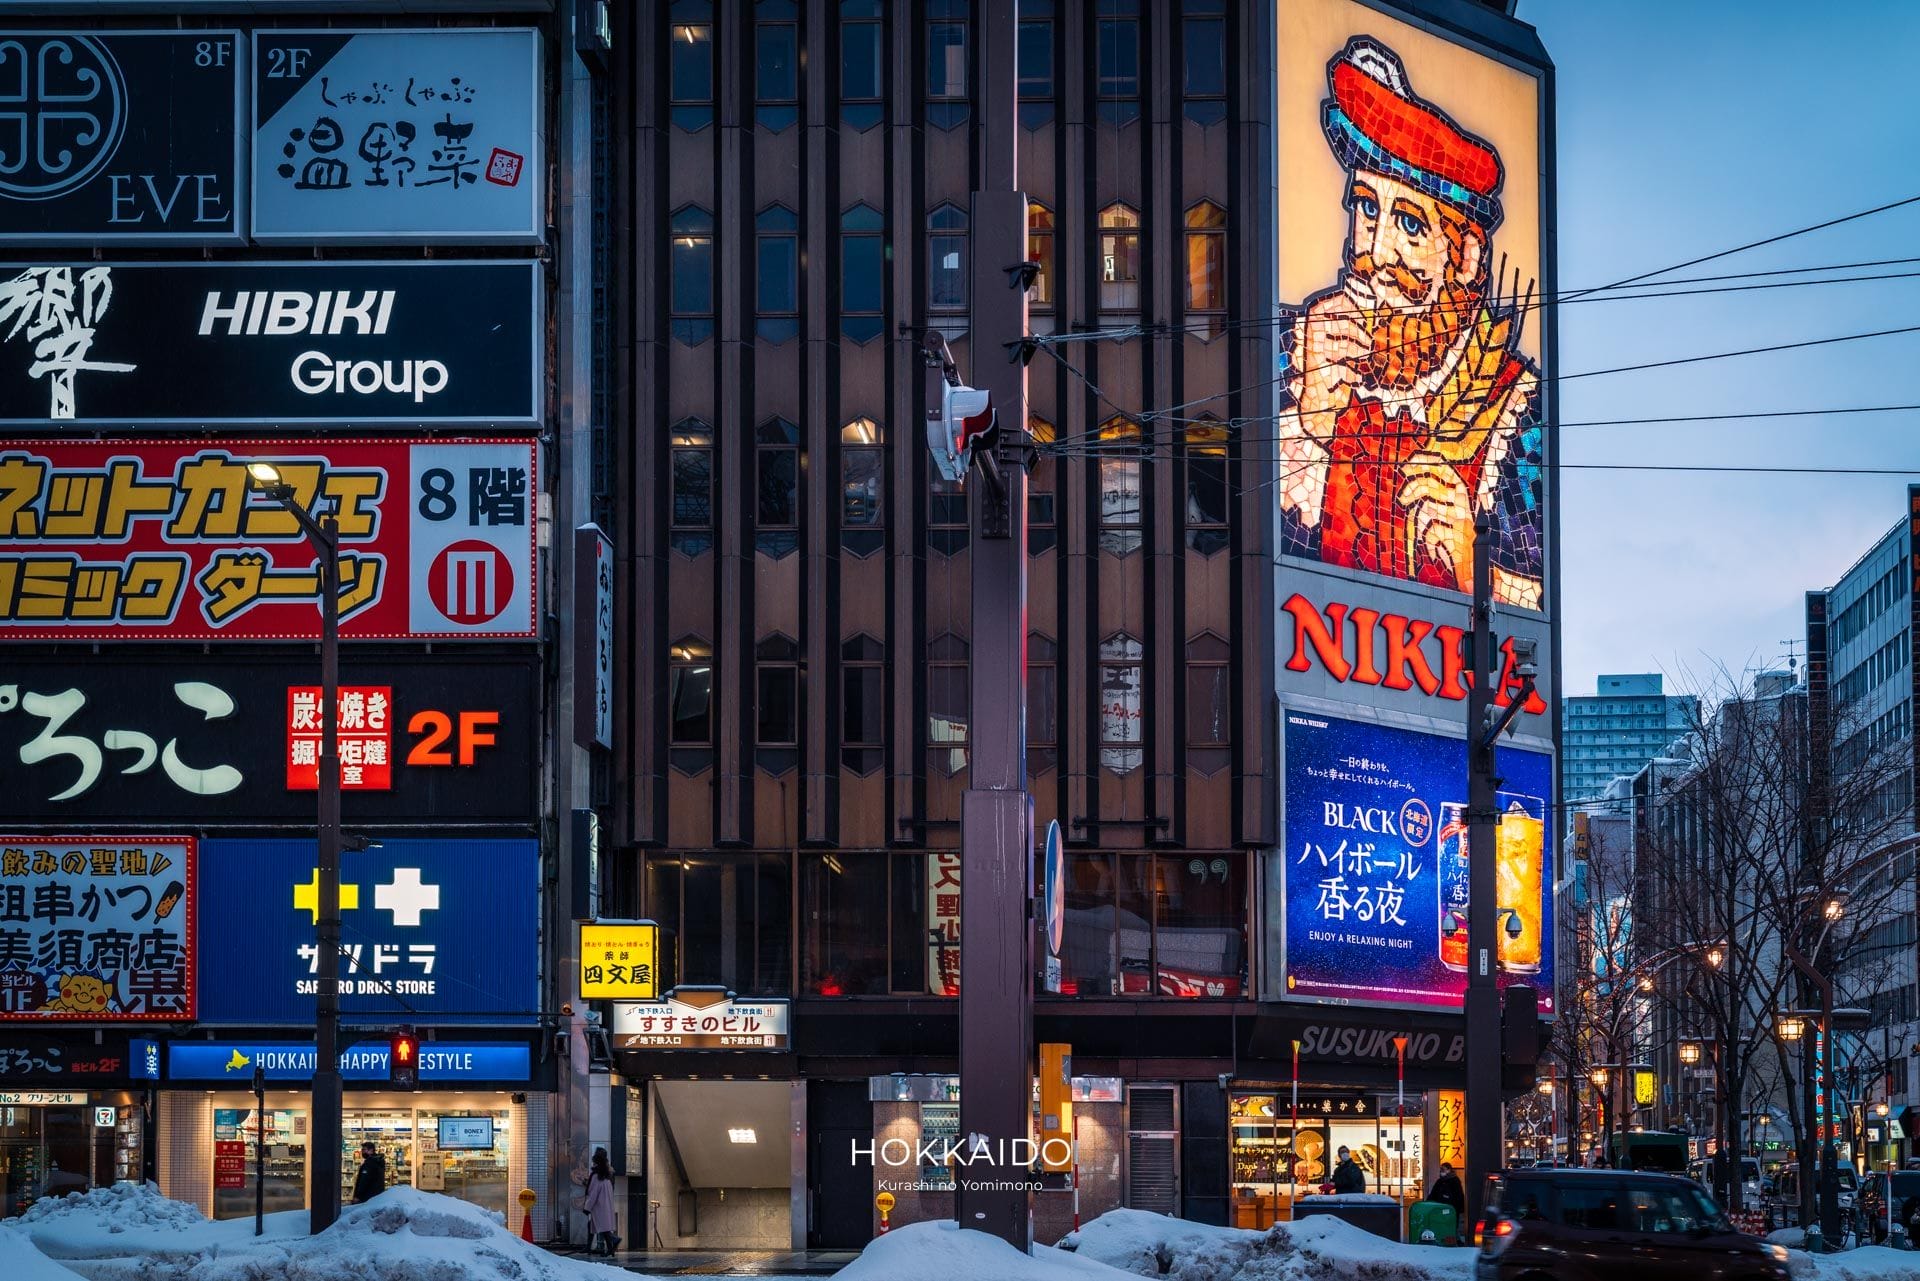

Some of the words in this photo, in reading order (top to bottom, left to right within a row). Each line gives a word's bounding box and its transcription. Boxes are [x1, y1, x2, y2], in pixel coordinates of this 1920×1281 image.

[195, 41, 231, 67] 8F
[267, 48, 311, 78] 2F
[321, 77, 475, 106] しゃぶしゃぶ
[277, 113, 478, 190] 温野菜
[108, 175, 230, 223] EVE
[199, 290, 396, 335] HIBIKI
[291, 350, 449, 402] Group
[0, 456, 383, 537] ネットカフェ
[419, 467, 526, 527] 8階
[0, 682, 243, 800] ろっこ
[291, 740, 387, 766] 掘炬燵
[407, 711, 499, 765] 2F
[1323, 801, 1397, 836] BLACK
[1297, 839, 1423, 881] ハイボール
[1315, 876, 1407, 926] 香る夜
[1309, 931, 1337, 943] ENJOY
[1338, 934, 1345, 943] A
[1346, 934, 1387, 947] RELAXING
[1388, 937, 1413, 949] NIGHT
[1, 974, 36, 987] 当ビル
[296, 980, 353, 994] SAPRO
[396, 981, 435, 995] STORE
[584, 964, 651, 984] 四文屋
[1, 989, 33, 1011] 1F
[638, 1007, 673, 1015] 地下鉄入口
[728, 1007, 763, 1015] 地下飲食街
[640, 1016, 760, 1032] すすきのビル
[640, 1036, 682, 1045] 地下鉄入口
[720, 1036, 762, 1045] 地下飲食街
[1300, 1025, 1441, 1061] SUSUKINO
[1445, 1035, 1464, 1062] B
[256, 1052, 317, 1070] HOKKAI
[341, 1052, 389, 1070] HAPPY
[1439, 1099, 1450, 1161] スクエア
[1451, 1098, 1464, 1160] タイムズ
